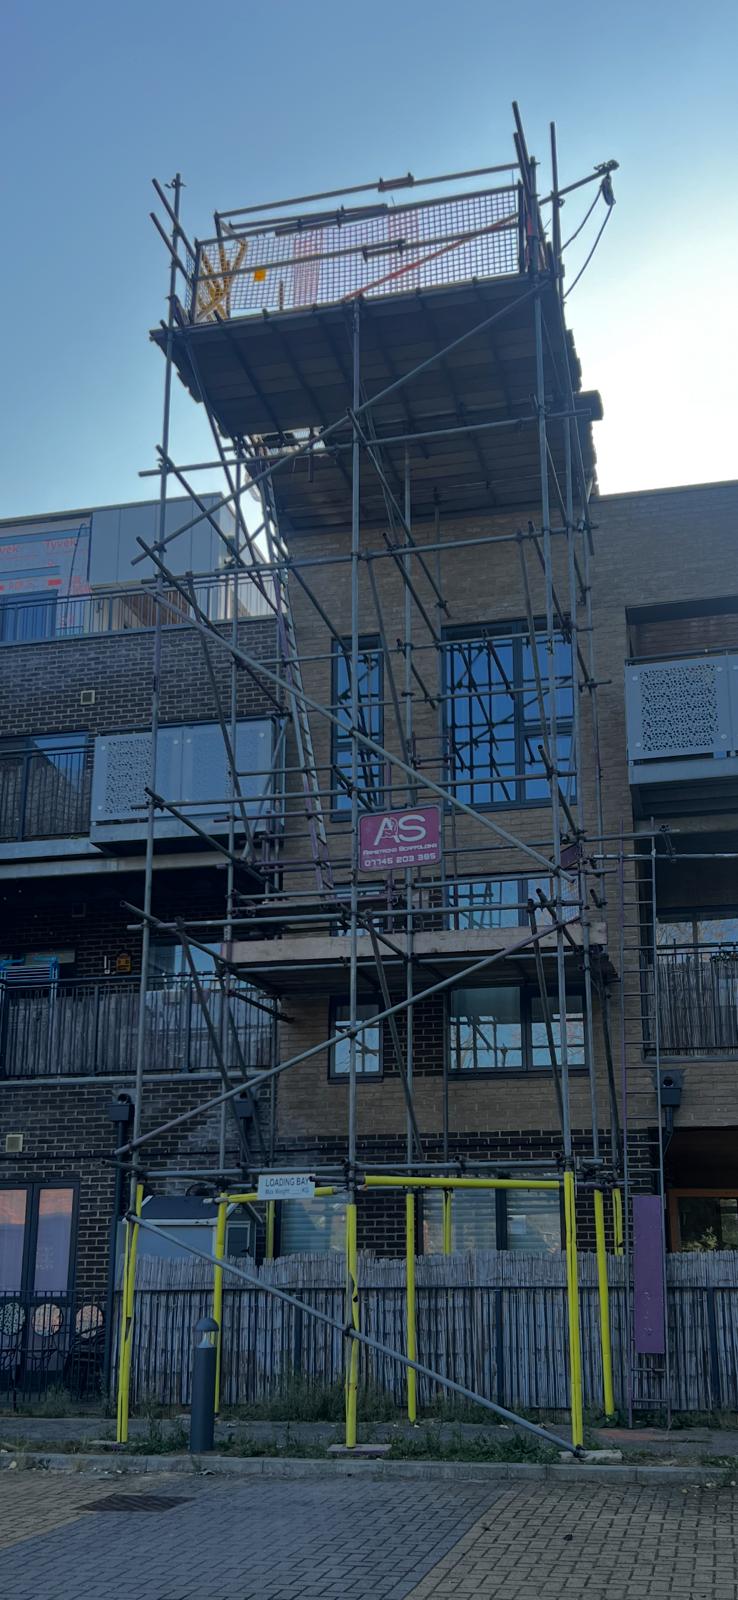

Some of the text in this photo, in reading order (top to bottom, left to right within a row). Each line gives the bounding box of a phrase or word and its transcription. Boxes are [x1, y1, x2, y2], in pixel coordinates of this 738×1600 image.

[374, 815, 426, 845] AS
[364, 857, 393, 867] 07745
[265, 1177, 309, 1187] LOADING BAY
